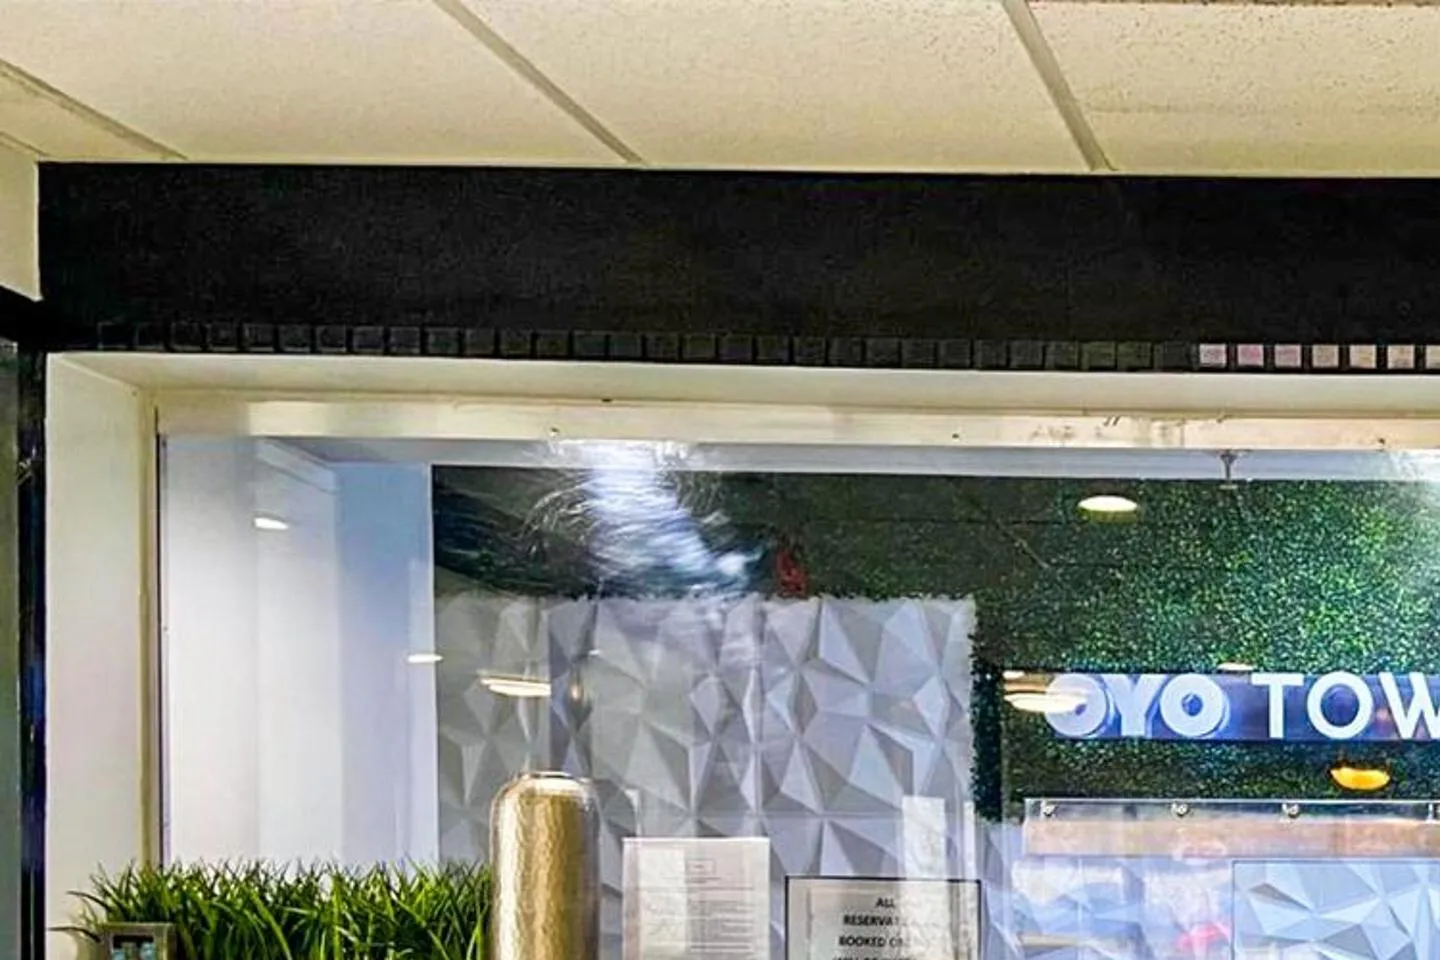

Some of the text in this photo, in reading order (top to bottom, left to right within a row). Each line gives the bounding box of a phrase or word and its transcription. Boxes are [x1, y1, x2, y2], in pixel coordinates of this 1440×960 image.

[1045, 672, 1226, 737] OYO
[875, 897, 896, 908] ALL
[838, 935, 886, 947] BOOKED
